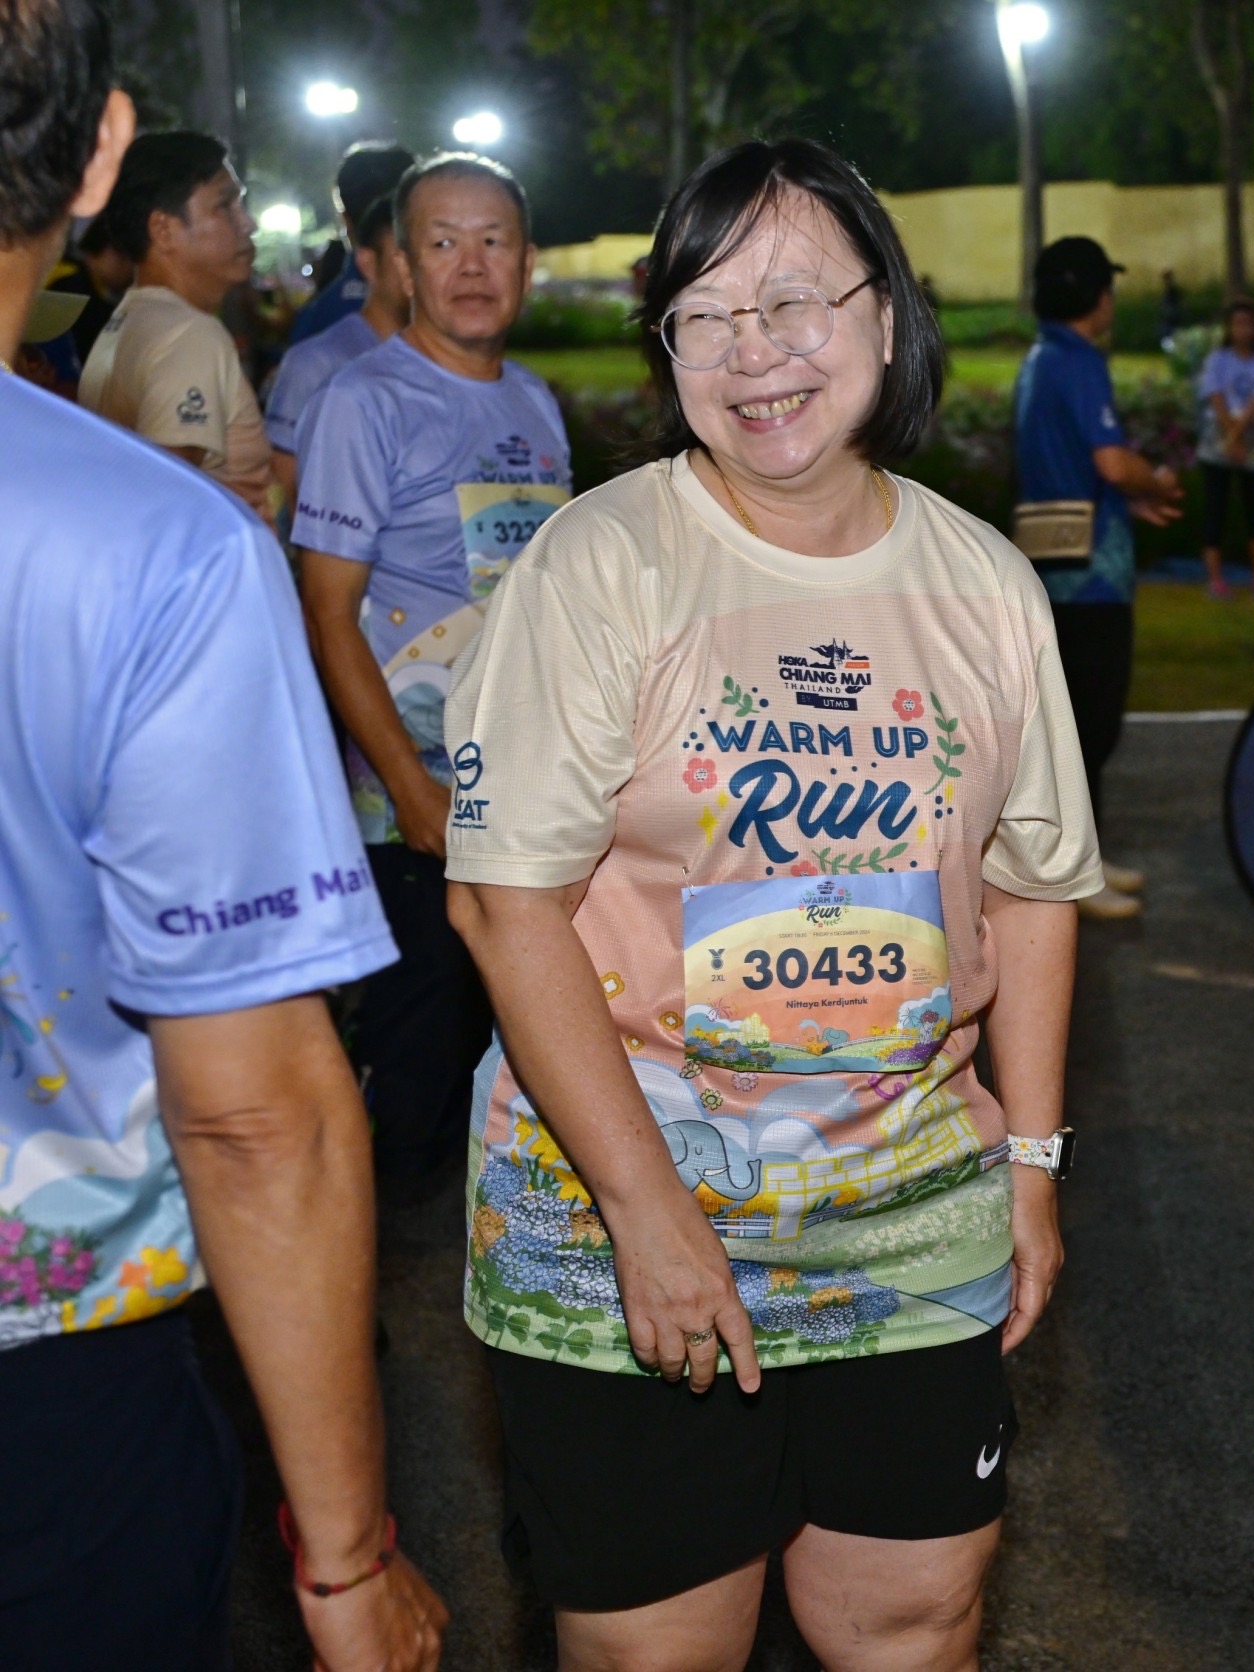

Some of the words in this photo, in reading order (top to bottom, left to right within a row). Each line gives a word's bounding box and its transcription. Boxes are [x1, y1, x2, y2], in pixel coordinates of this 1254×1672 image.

[328, 508, 363, 530] PAO
[778, 654, 808, 668] HOKA
[779, 667, 837, 685] CHIANG
[841, 672, 872, 686] MAI
[784, 682, 841, 694] THAILAND
[823, 698, 850, 709] UTMB
[706, 719, 854, 757] WARM
[872, 726, 929, 759] UP
[727, 758, 918, 864] Run
[157, 886, 300, 936] Chiang
[311, 858, 373, 903] Mai
[802, 896, 831, 905] WARM
[834, 895, 845, 903] UP
[806, 904, 842, 924] Run
[742, 942, 907, 990] 30433
[711, 974, 726, 982] 2XL
[786, 1000, 819, 1010] Nittaya
